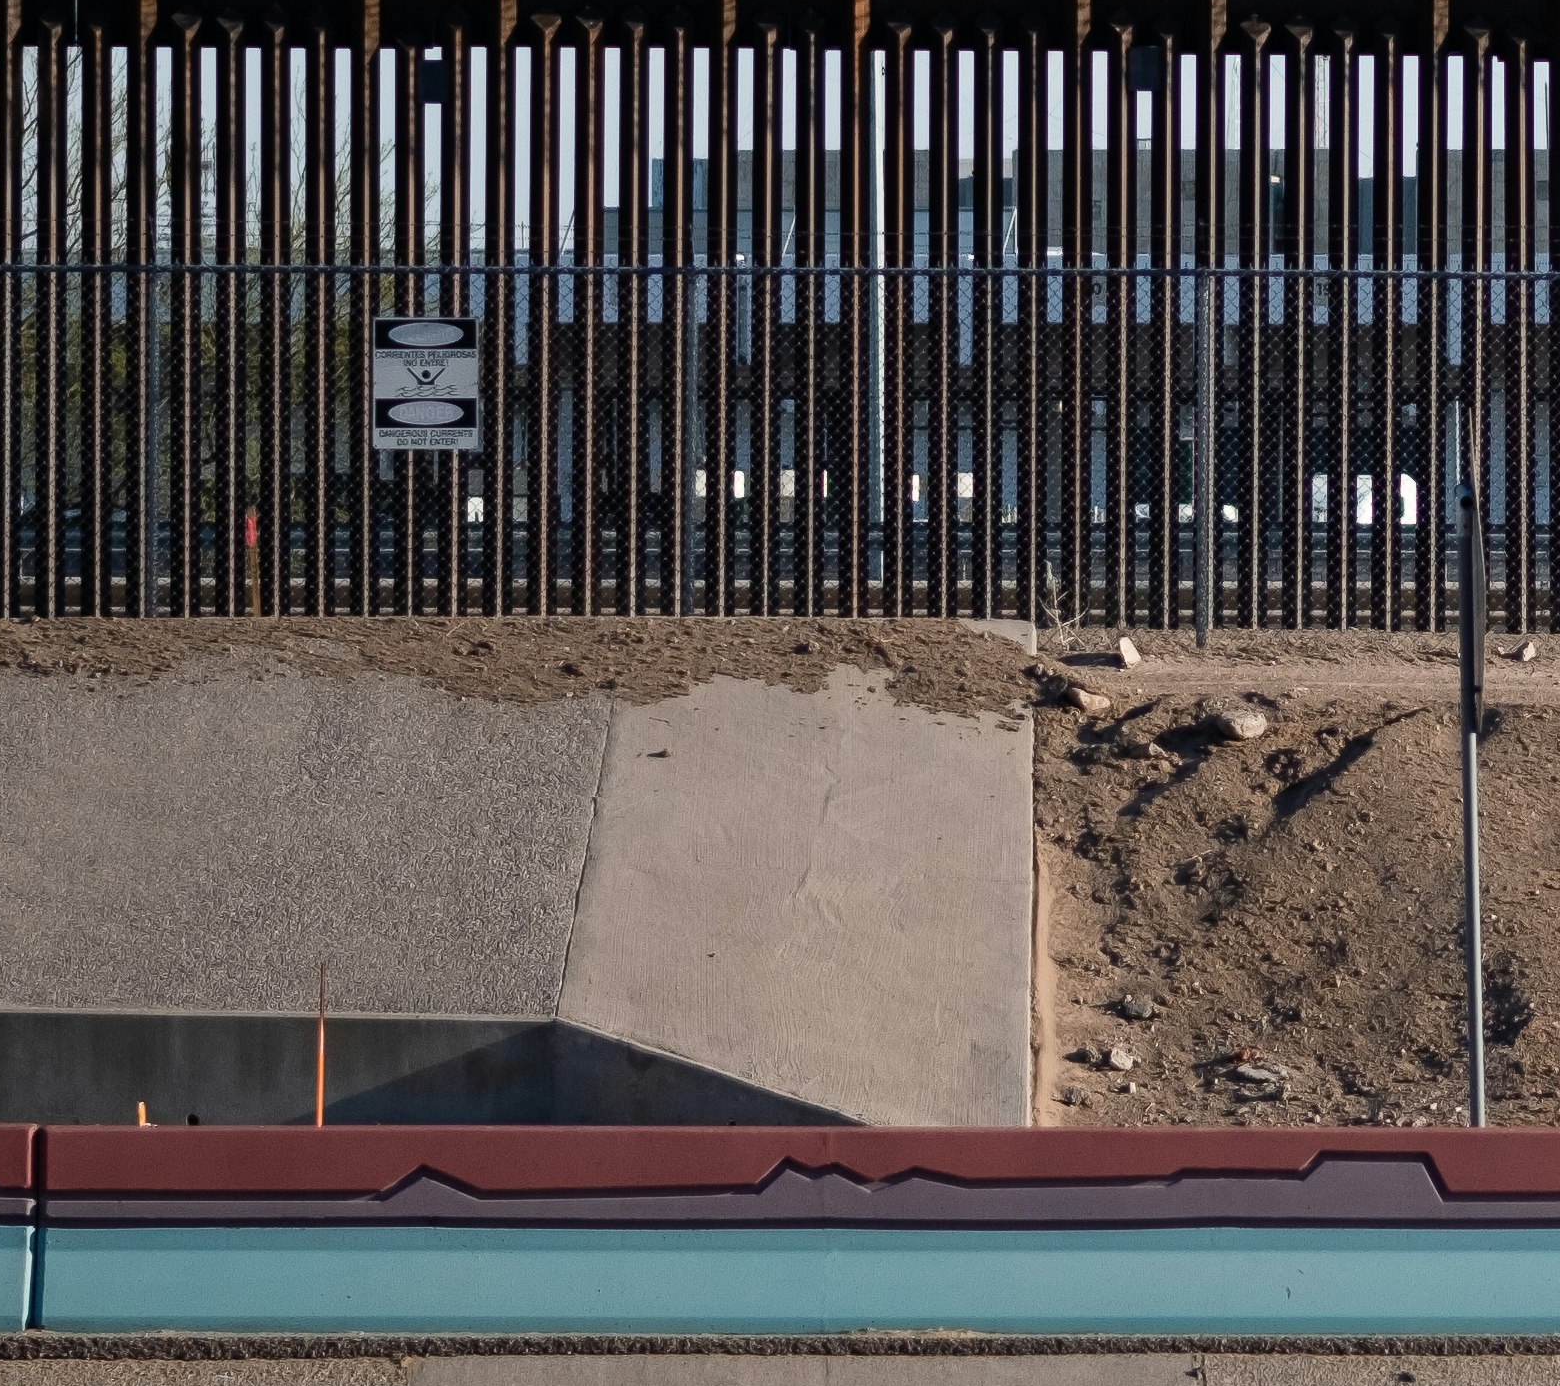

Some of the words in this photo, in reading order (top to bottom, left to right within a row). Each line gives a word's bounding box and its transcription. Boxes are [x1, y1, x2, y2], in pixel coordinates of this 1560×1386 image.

[379, 429, 428, 438] DANGEROUS
[430, 429, 473, 438] CURRENTS
[410, 438, 427, 446] NOT
